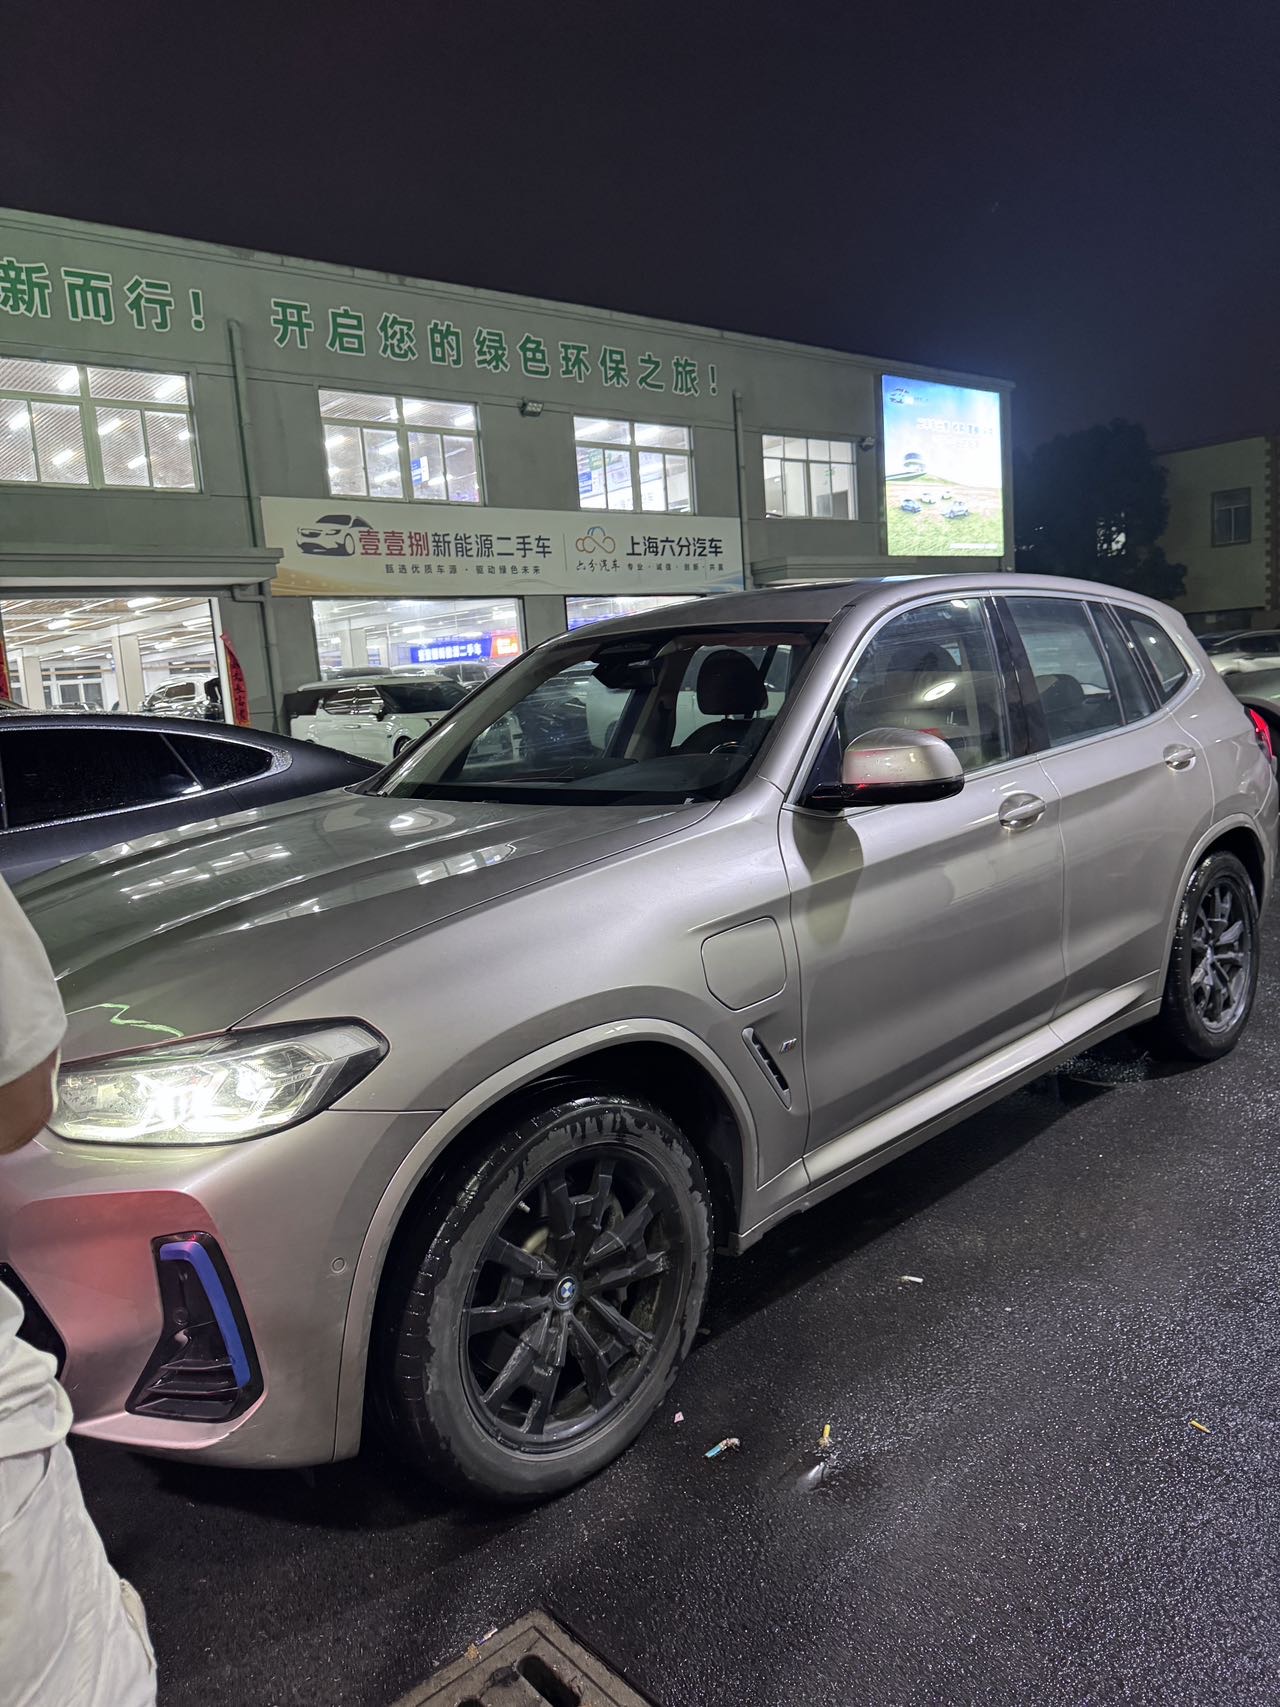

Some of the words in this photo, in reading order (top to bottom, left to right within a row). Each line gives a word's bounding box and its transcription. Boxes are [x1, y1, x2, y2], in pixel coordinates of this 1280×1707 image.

[0, 257, 205, 331] 新而行！
[271, 298, 718, 397] 开启您的绿色环保之旅！
[358, 528, 552, 558] 壹壹捌新能源二手车
[626, 535, 723, 557] 上海六分汽车
